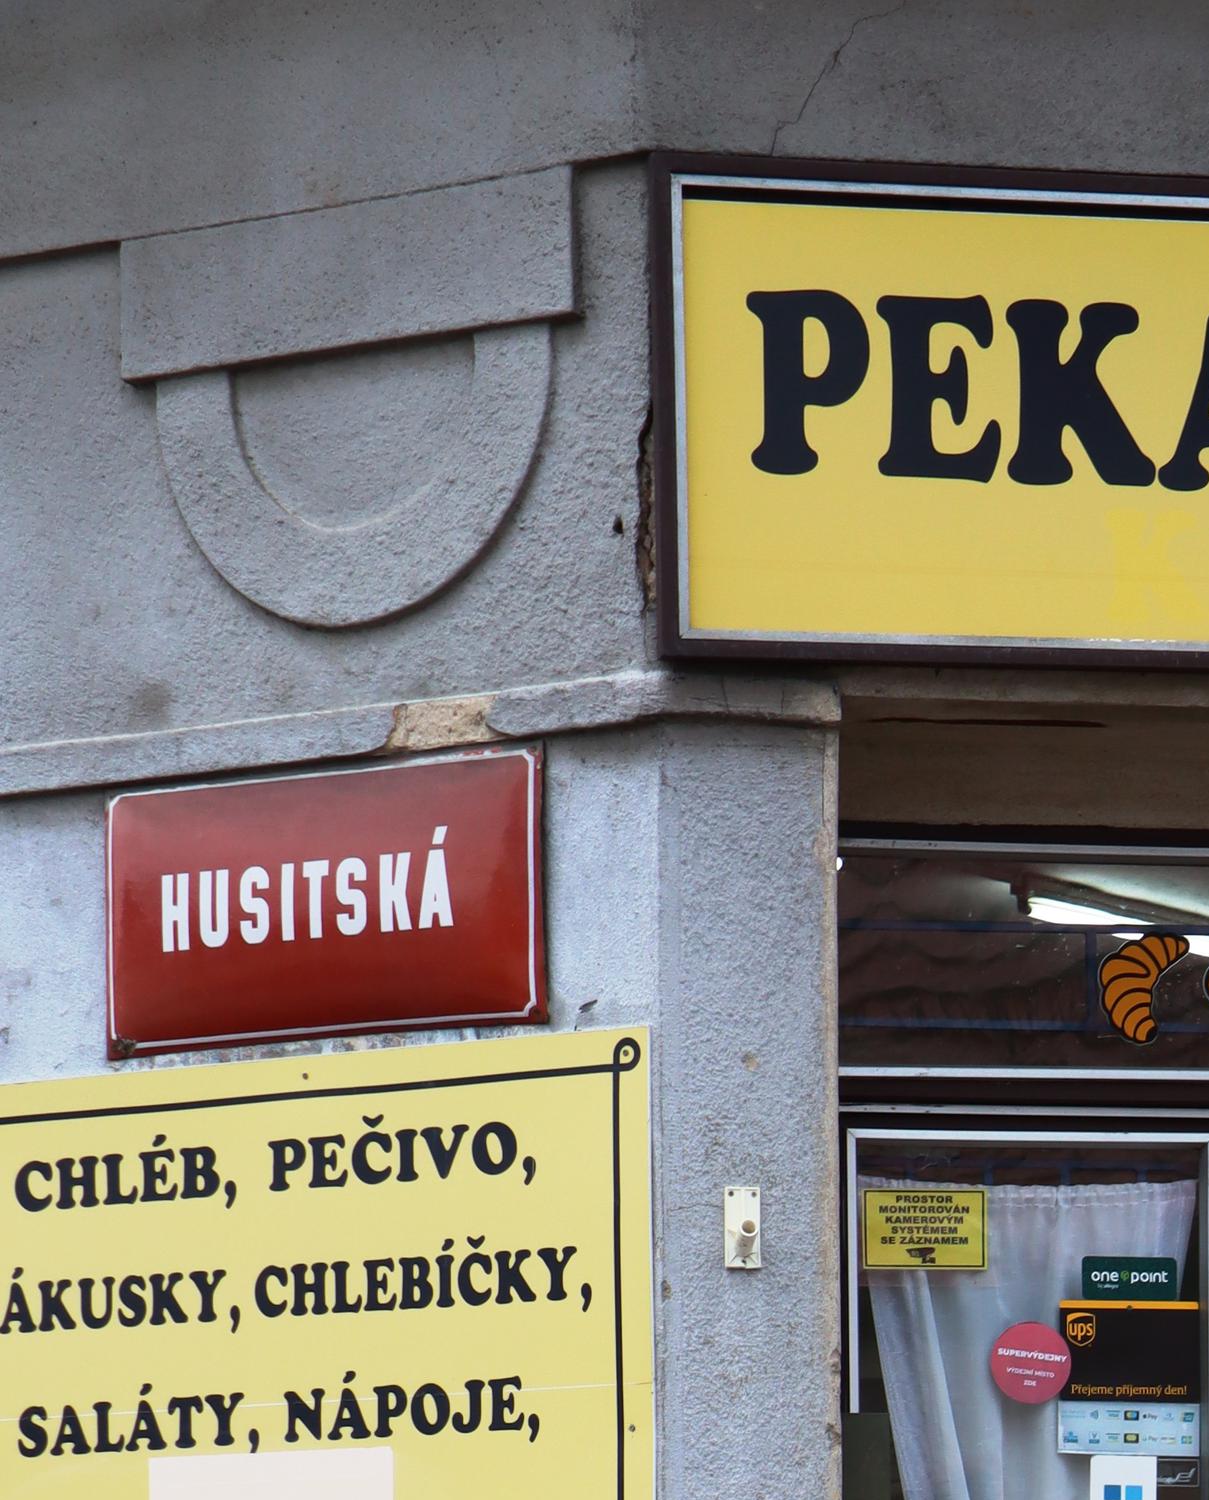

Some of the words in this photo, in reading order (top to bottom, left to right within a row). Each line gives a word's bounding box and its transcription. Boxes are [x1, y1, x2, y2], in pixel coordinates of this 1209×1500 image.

[161, 825, 454, 953] HUSITSKÁ
[14, 1134, 237, 1212] CHLÉB,
[268, 1114, 537, 1192] PEČIVO,
[895, 1195, 953, 1203] PROSTOR
[879, 1204, 970, 1214] MONITOROVÁN
[885, 1214, 964, 1224] KAMEROVÝM
[891, 1224, 958, 1234] SYSTÉMEM
[880, 1236, 896, 1244] SE
[899, 1234, 969, 1244] ZÁZNAMEM
[254, 1236, 593, 1318] CHLEBÍČKY,
[1090, 1271, 1119, 1282] one
[1130, 1270, 1169, 1284] point
[1069, 1322, 1093, 1341] ups
[1071, 1384, 1113, 1396] Přejeme
[1115, 1384, 1162, 1397] příjemný
[1164, 1385, 1187, 1396] den!
[18, 1383, 260, 1457] SALÁTY,
[284, 1370, 540, 1443] NÁPOJE,
